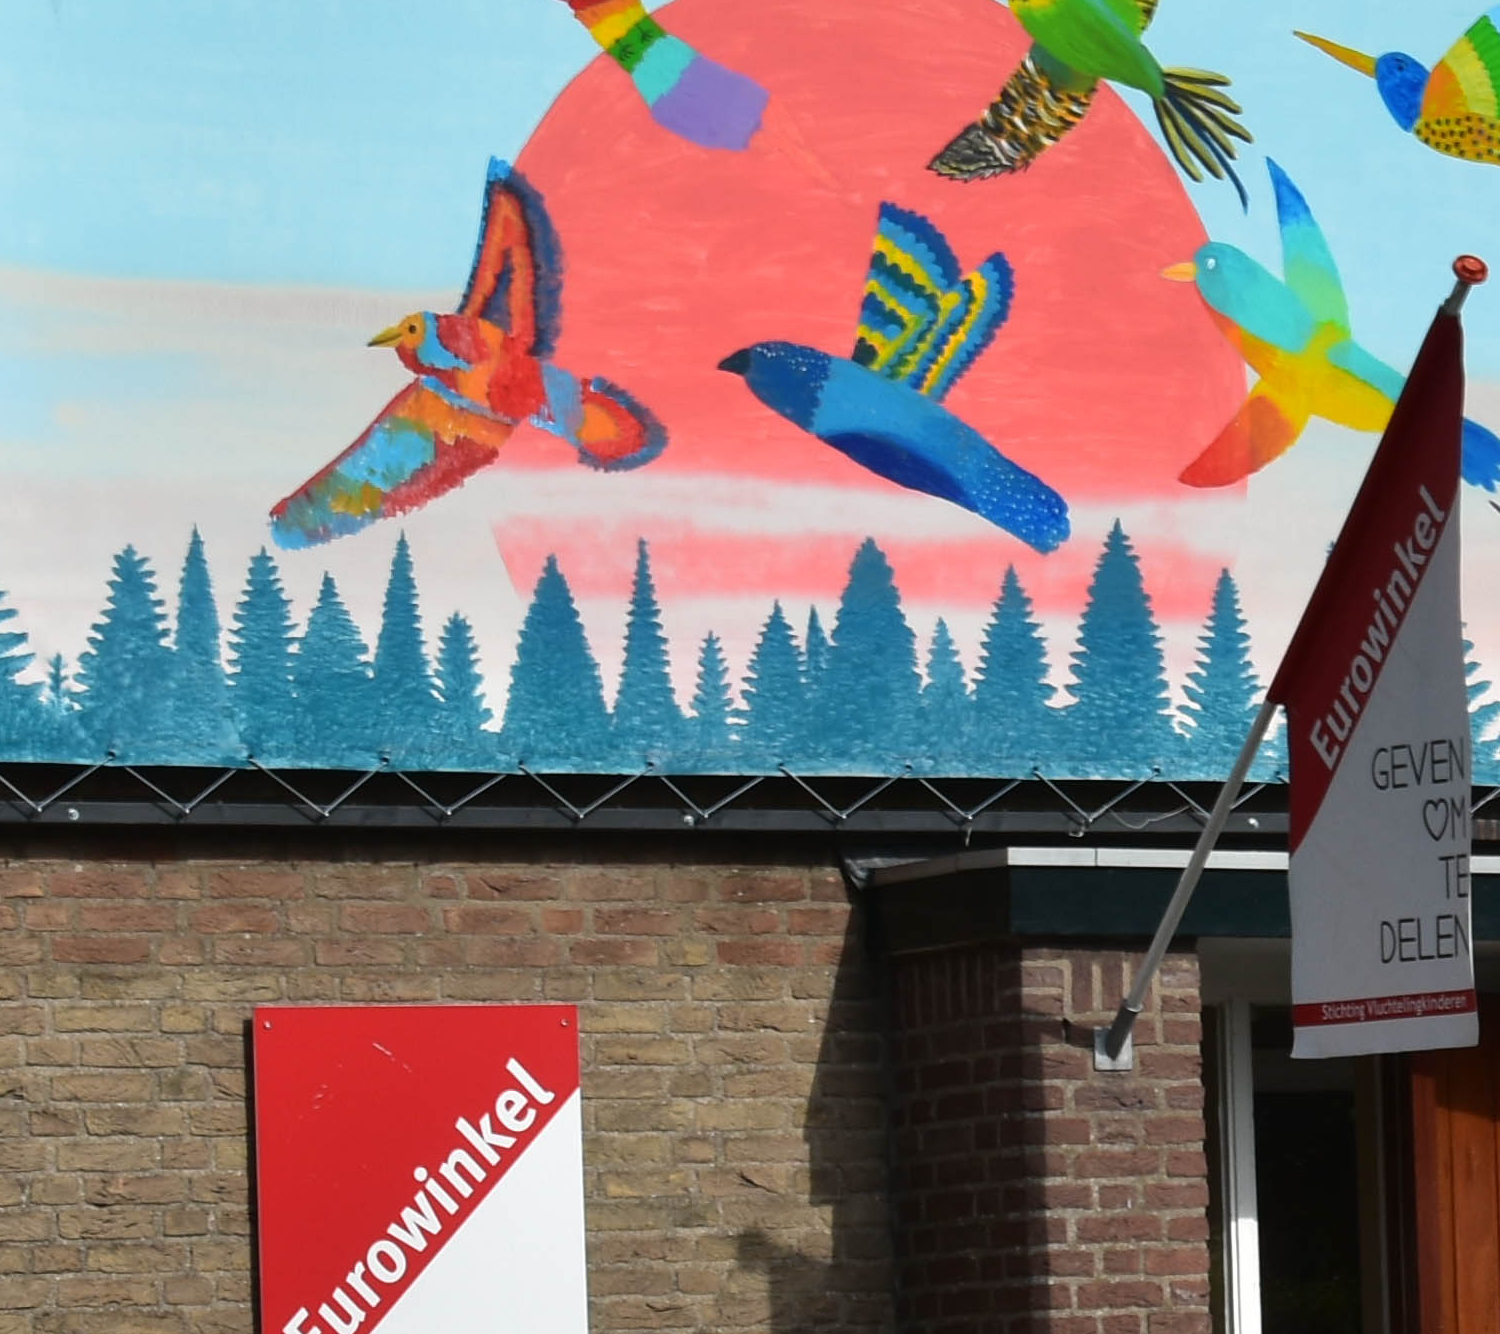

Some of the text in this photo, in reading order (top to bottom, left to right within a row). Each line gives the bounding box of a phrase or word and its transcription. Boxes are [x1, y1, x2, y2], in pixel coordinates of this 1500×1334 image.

[1310, 484, 1446, 773] Eurowinkel
[1371, 736, 1465, 792] GEVEN
[1439, 853, 1468, 901] TE
[1380, 915, 1468, 965] DELEN
[1321, 991, 1467, 1024] Stichting Vluchtelingkinderen
